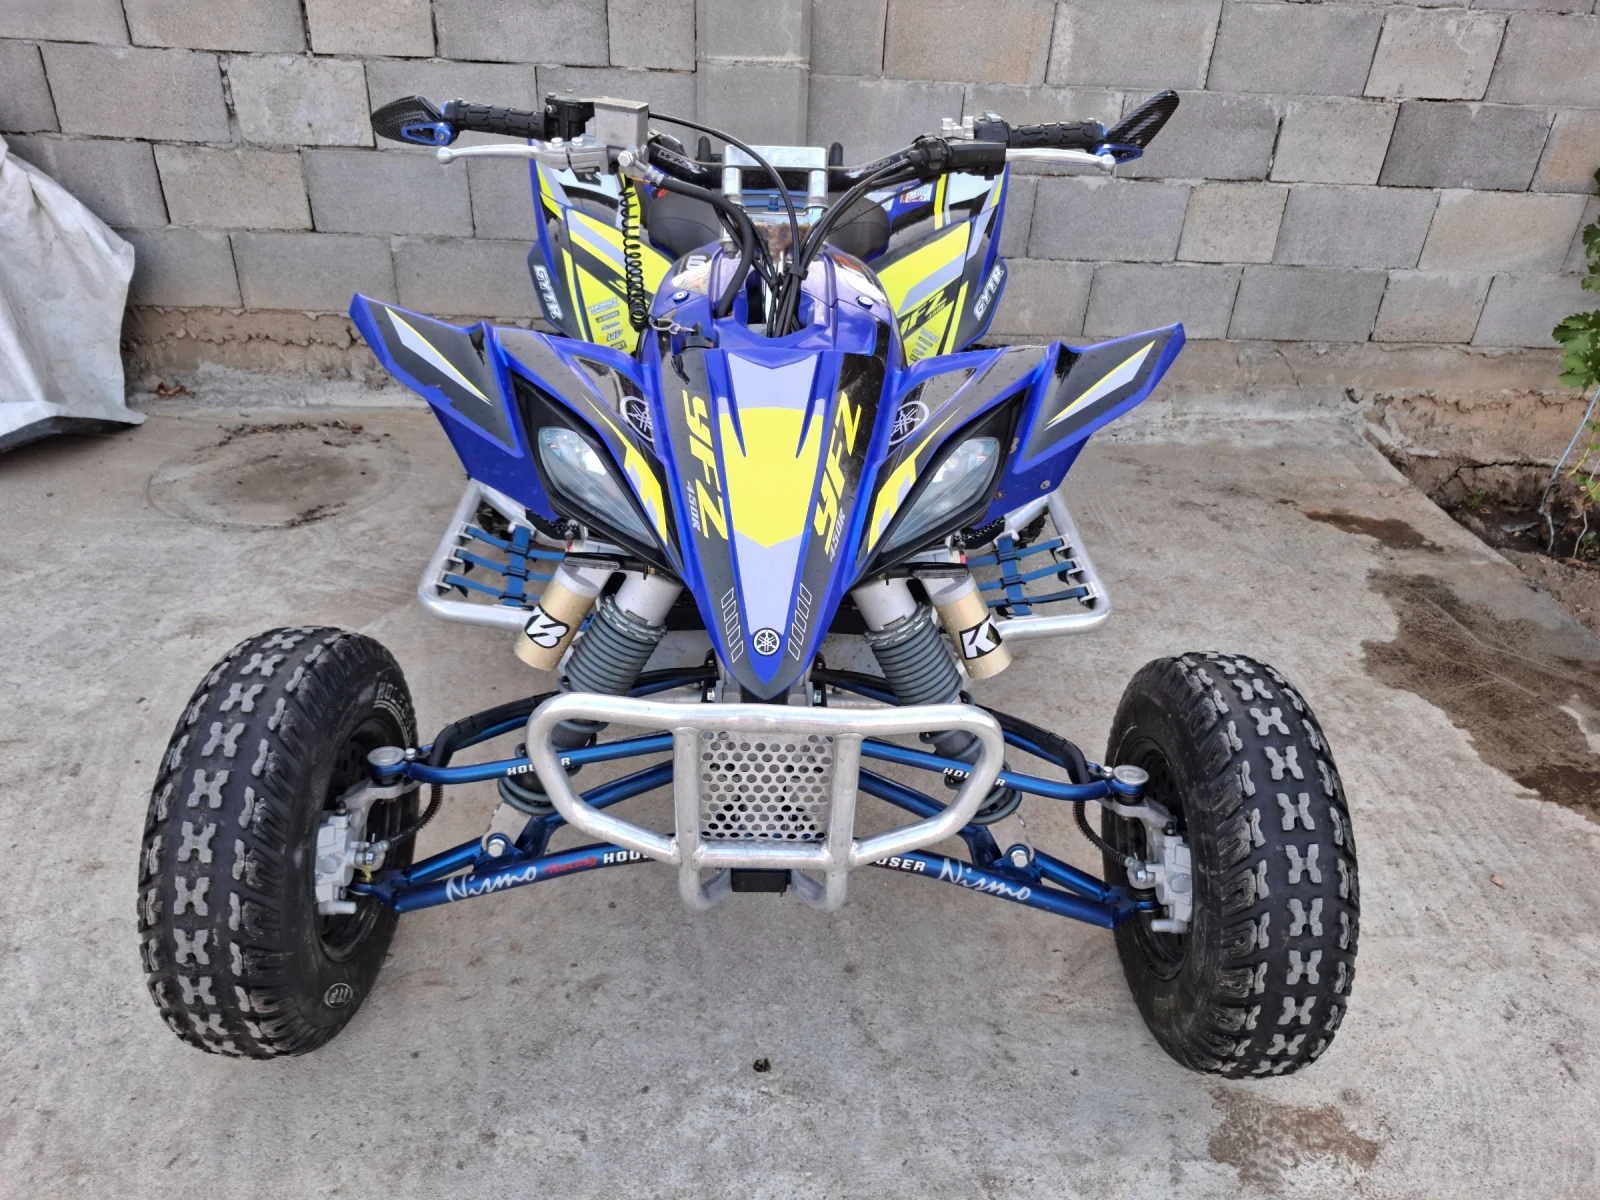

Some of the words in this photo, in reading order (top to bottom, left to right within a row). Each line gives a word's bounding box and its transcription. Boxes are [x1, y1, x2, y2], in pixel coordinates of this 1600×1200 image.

[533, 264, 563, 320] GYTR
[973, 264, 1004, 321] GYTR
[682, 389, 729, 540] YFZ
[814, 391, 862, 555] YFZ
[686, 480, 701, 533] 450R
[830, 507, 846, 562] 450R
[446, 866, 537, 902] Nismo
[603, 850, 649, 864] HOU
[937, 857, 1031, 900] Nismo
